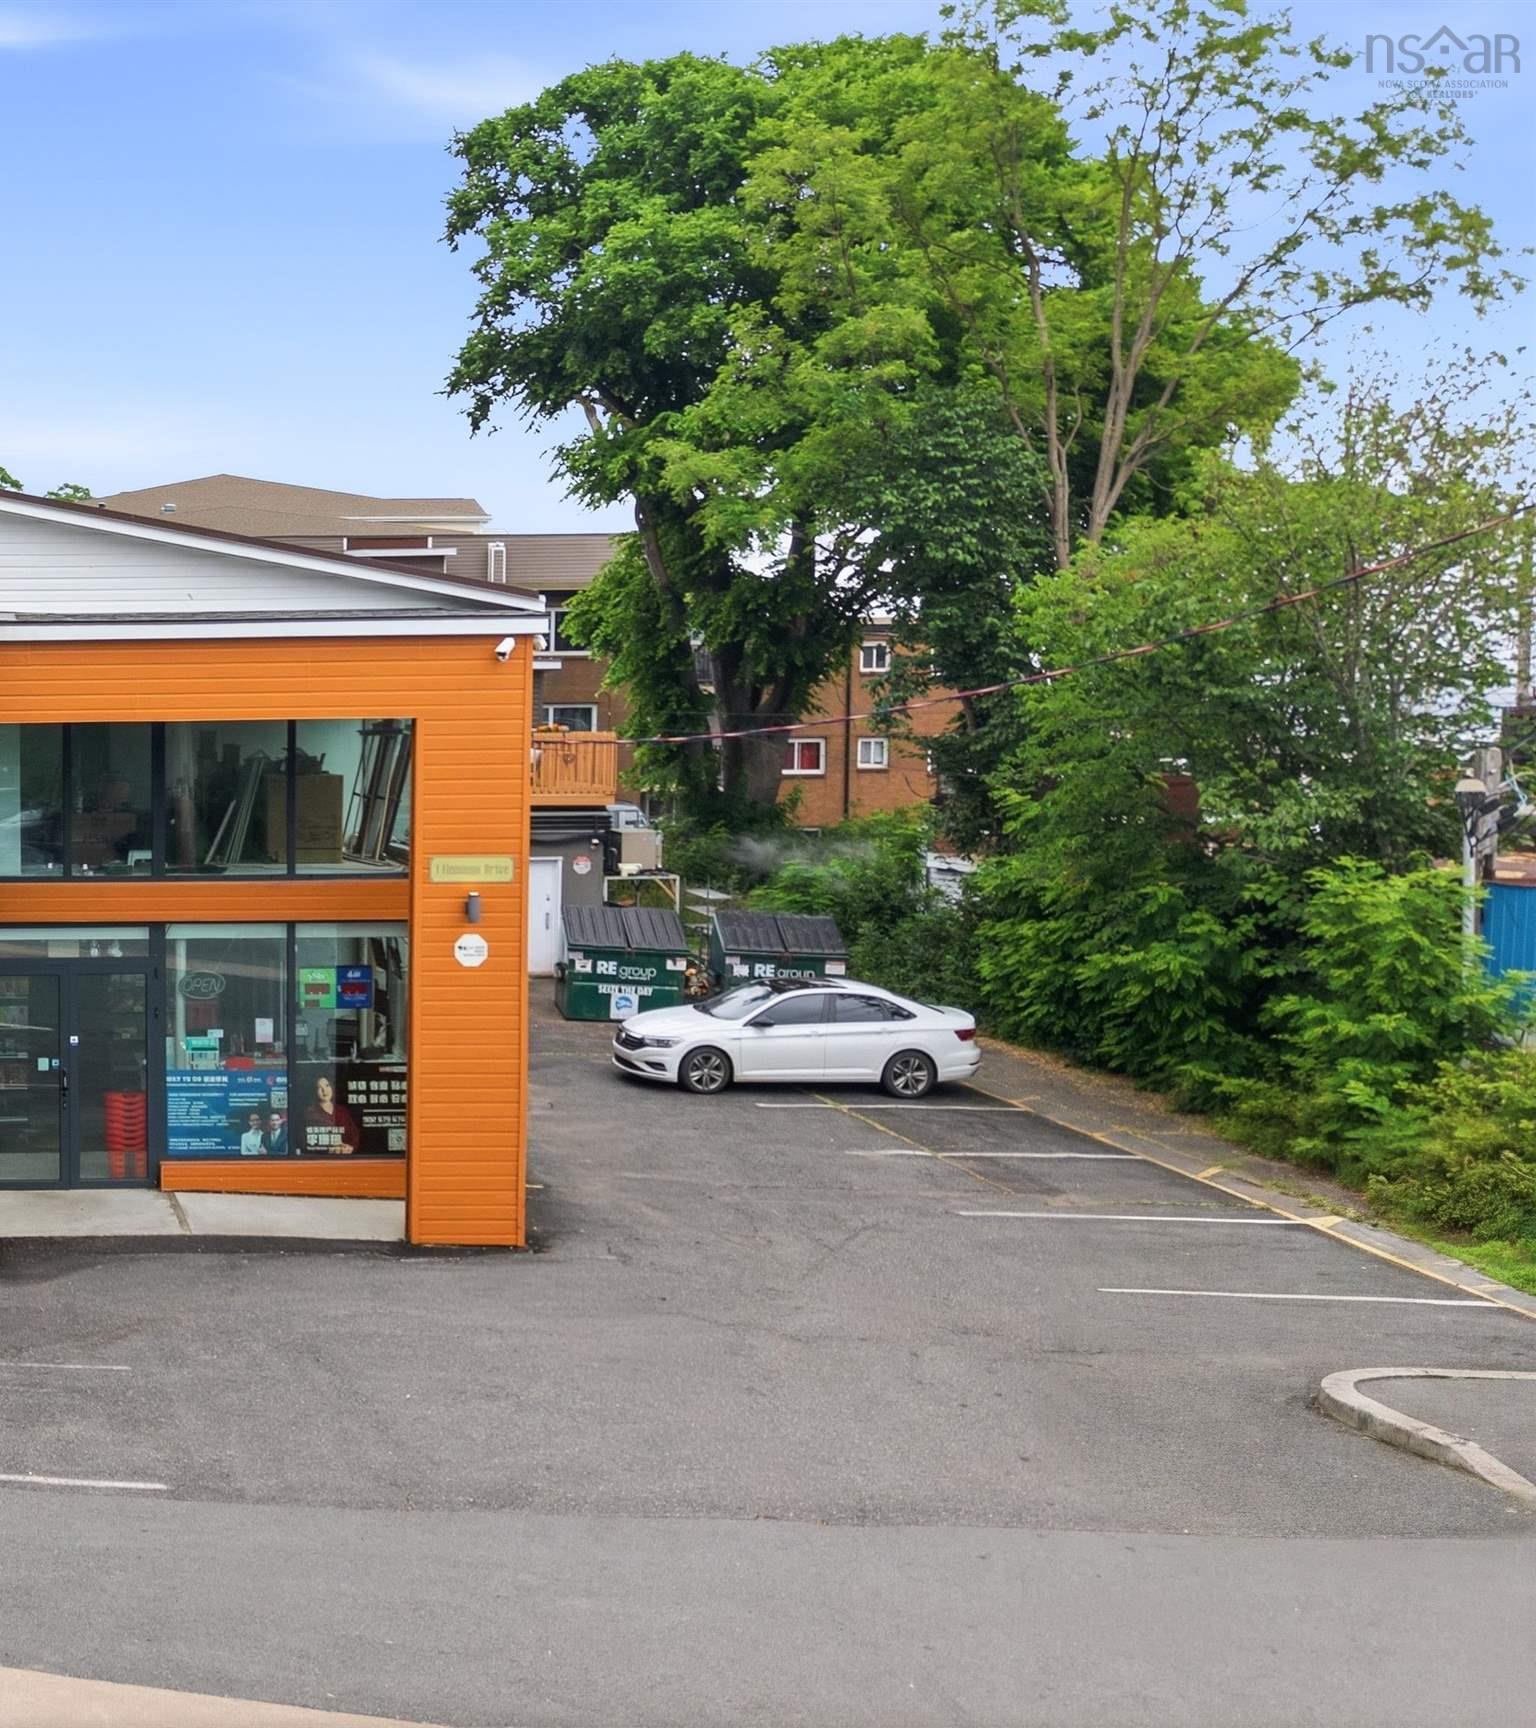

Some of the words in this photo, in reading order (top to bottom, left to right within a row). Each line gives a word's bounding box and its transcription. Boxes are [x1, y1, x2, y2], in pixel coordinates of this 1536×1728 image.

[596, 960, 618, 975] RE
[619, 966, 657, 980] group
[754, 963, 776, 977] RE
[183, 978, 222, 992] OPEN
